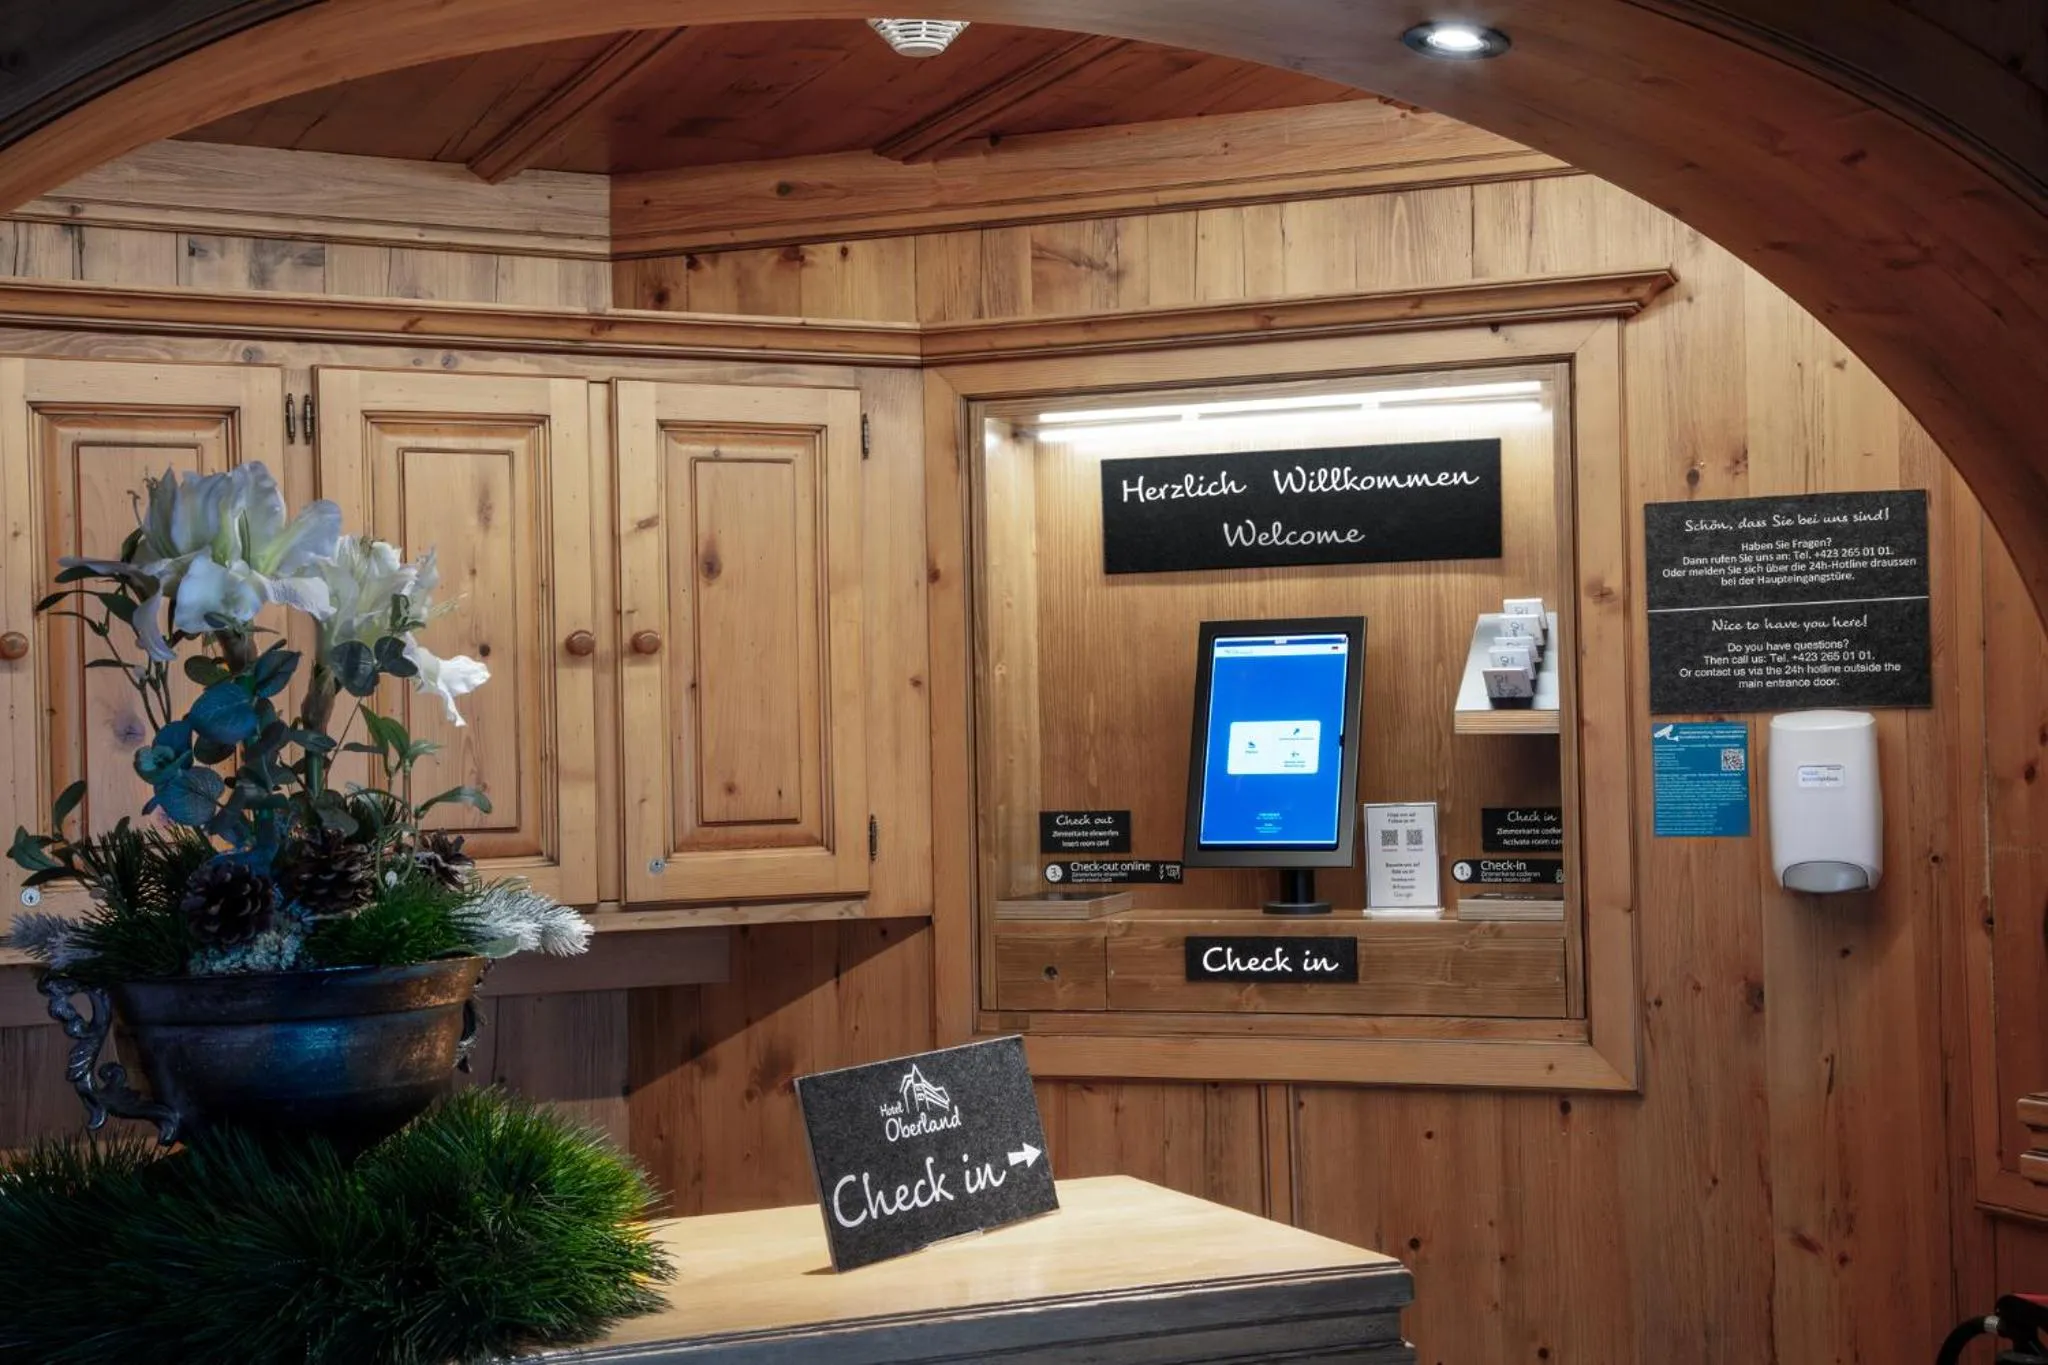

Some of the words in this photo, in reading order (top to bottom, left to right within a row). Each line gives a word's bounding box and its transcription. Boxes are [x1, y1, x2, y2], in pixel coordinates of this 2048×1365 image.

[1122, 470, 1247, 503] Herzlich
[1272, 465, 1479, 495] Willkommen
[1738, 517, 1767, 529] dass
[1772, 514, 1794, 528] Sie
[1797, 513, 1820, 525] bei
[1823, 515, 1848, 524] uns
[1853, 507, 1889, 522] sind!
[1223, 519, 1365, 548] Welcome
[1741, 541, 1773, 551] Haben
[1775, 540, 1791, 550] Sie
[1792, 537, 1832, 550] Fragen?
[1682, 556, 1708, 566] Dann
[1710, 555, 1738, 564] rufen
[1739, 553, 1753, 563] Sie
[1755, 553, 1774, 562] uns
[1775, 552, 1791, 561] an:
[1793, 551, 1812, 560] Tel.
[1814, 548, 1839, 558] +423
[1841, 547, 1860, 558] 265
[1862, 546, 1875, 556] 01
[1662, 568, 1686, 578] Oder
[1688, 566, 1725, 576] melden
[1727, 565, 1742, 575] Sie
[1744, 564, 1763, 574] sich
[1766, 563, 1788, 573] über
[1790, 562, 1807, 571] die
[1808, 559, 1868, 571] 24h-Hotline
[1870, 558, 1917, 568] draussen
[1721, 576, 1736, 586] bei
[1738, 576, 1754, 585] der
[1757, 572, 1855, 586] Haupteingangstüre.
[1711, 618, 1744, 632] Nice
[1746, 620, 1760, 630] to
[1764, 617, 1800, 629] have
[1803, 620, 1830, 633] you
[1832, 613, 1867, 628] here!
[1727, 642, 1742, 652] Do
[1744, 643, 1763, 654] you
[1766, 641, 1791, 651] have
[1793, 638, 1850, 652] questions?
[1703, 655, 1729, 665] Then
[1732, 654, 1749, 664] call
[1751, 654, 1767, 664] us:
[1769, 653, 1789, 663] Tel.
[1792, 651, 1818, 662] +423
[1820, 651, 1840, 661] 265
[1842, 650, 1855, 661] 01
[1858, 650, 1876, 660] 01.
[1679, 667, 1691, 678] Or
[1694, 667, 1731, 677] contact
[1733, 668, 1746, 677] us
[1748, 666, 1763, 676] via
[1766, 665, 1782, 676] the
[1784, 665, 1804, 675] 24h
[1843, 662, 1881, 673] outside
[1884, 662, 1901, 672] the
[1738, 679, 1763, 689] main
[1765, 679, 1811, 688] entrance
[1813, 677, 1840, 687] door.
[1056, 814, 1091, 826] Check
[1094, 816, 1114, 824] out
[1507, 810, 1541, 823] Check
[1543, 812, 1557, 822] in
[1070, 861, 1118, 872] Check-out
[1120, 861, 1151, 872] online
[1202, 946, 1293, 972] Check
[1302, 949, 1340, 972] in
[885, 1105, 962, 1142] Oberland
[832, 1156, 955, 1229] Check
[961, 1152, 1007, 1194] in
